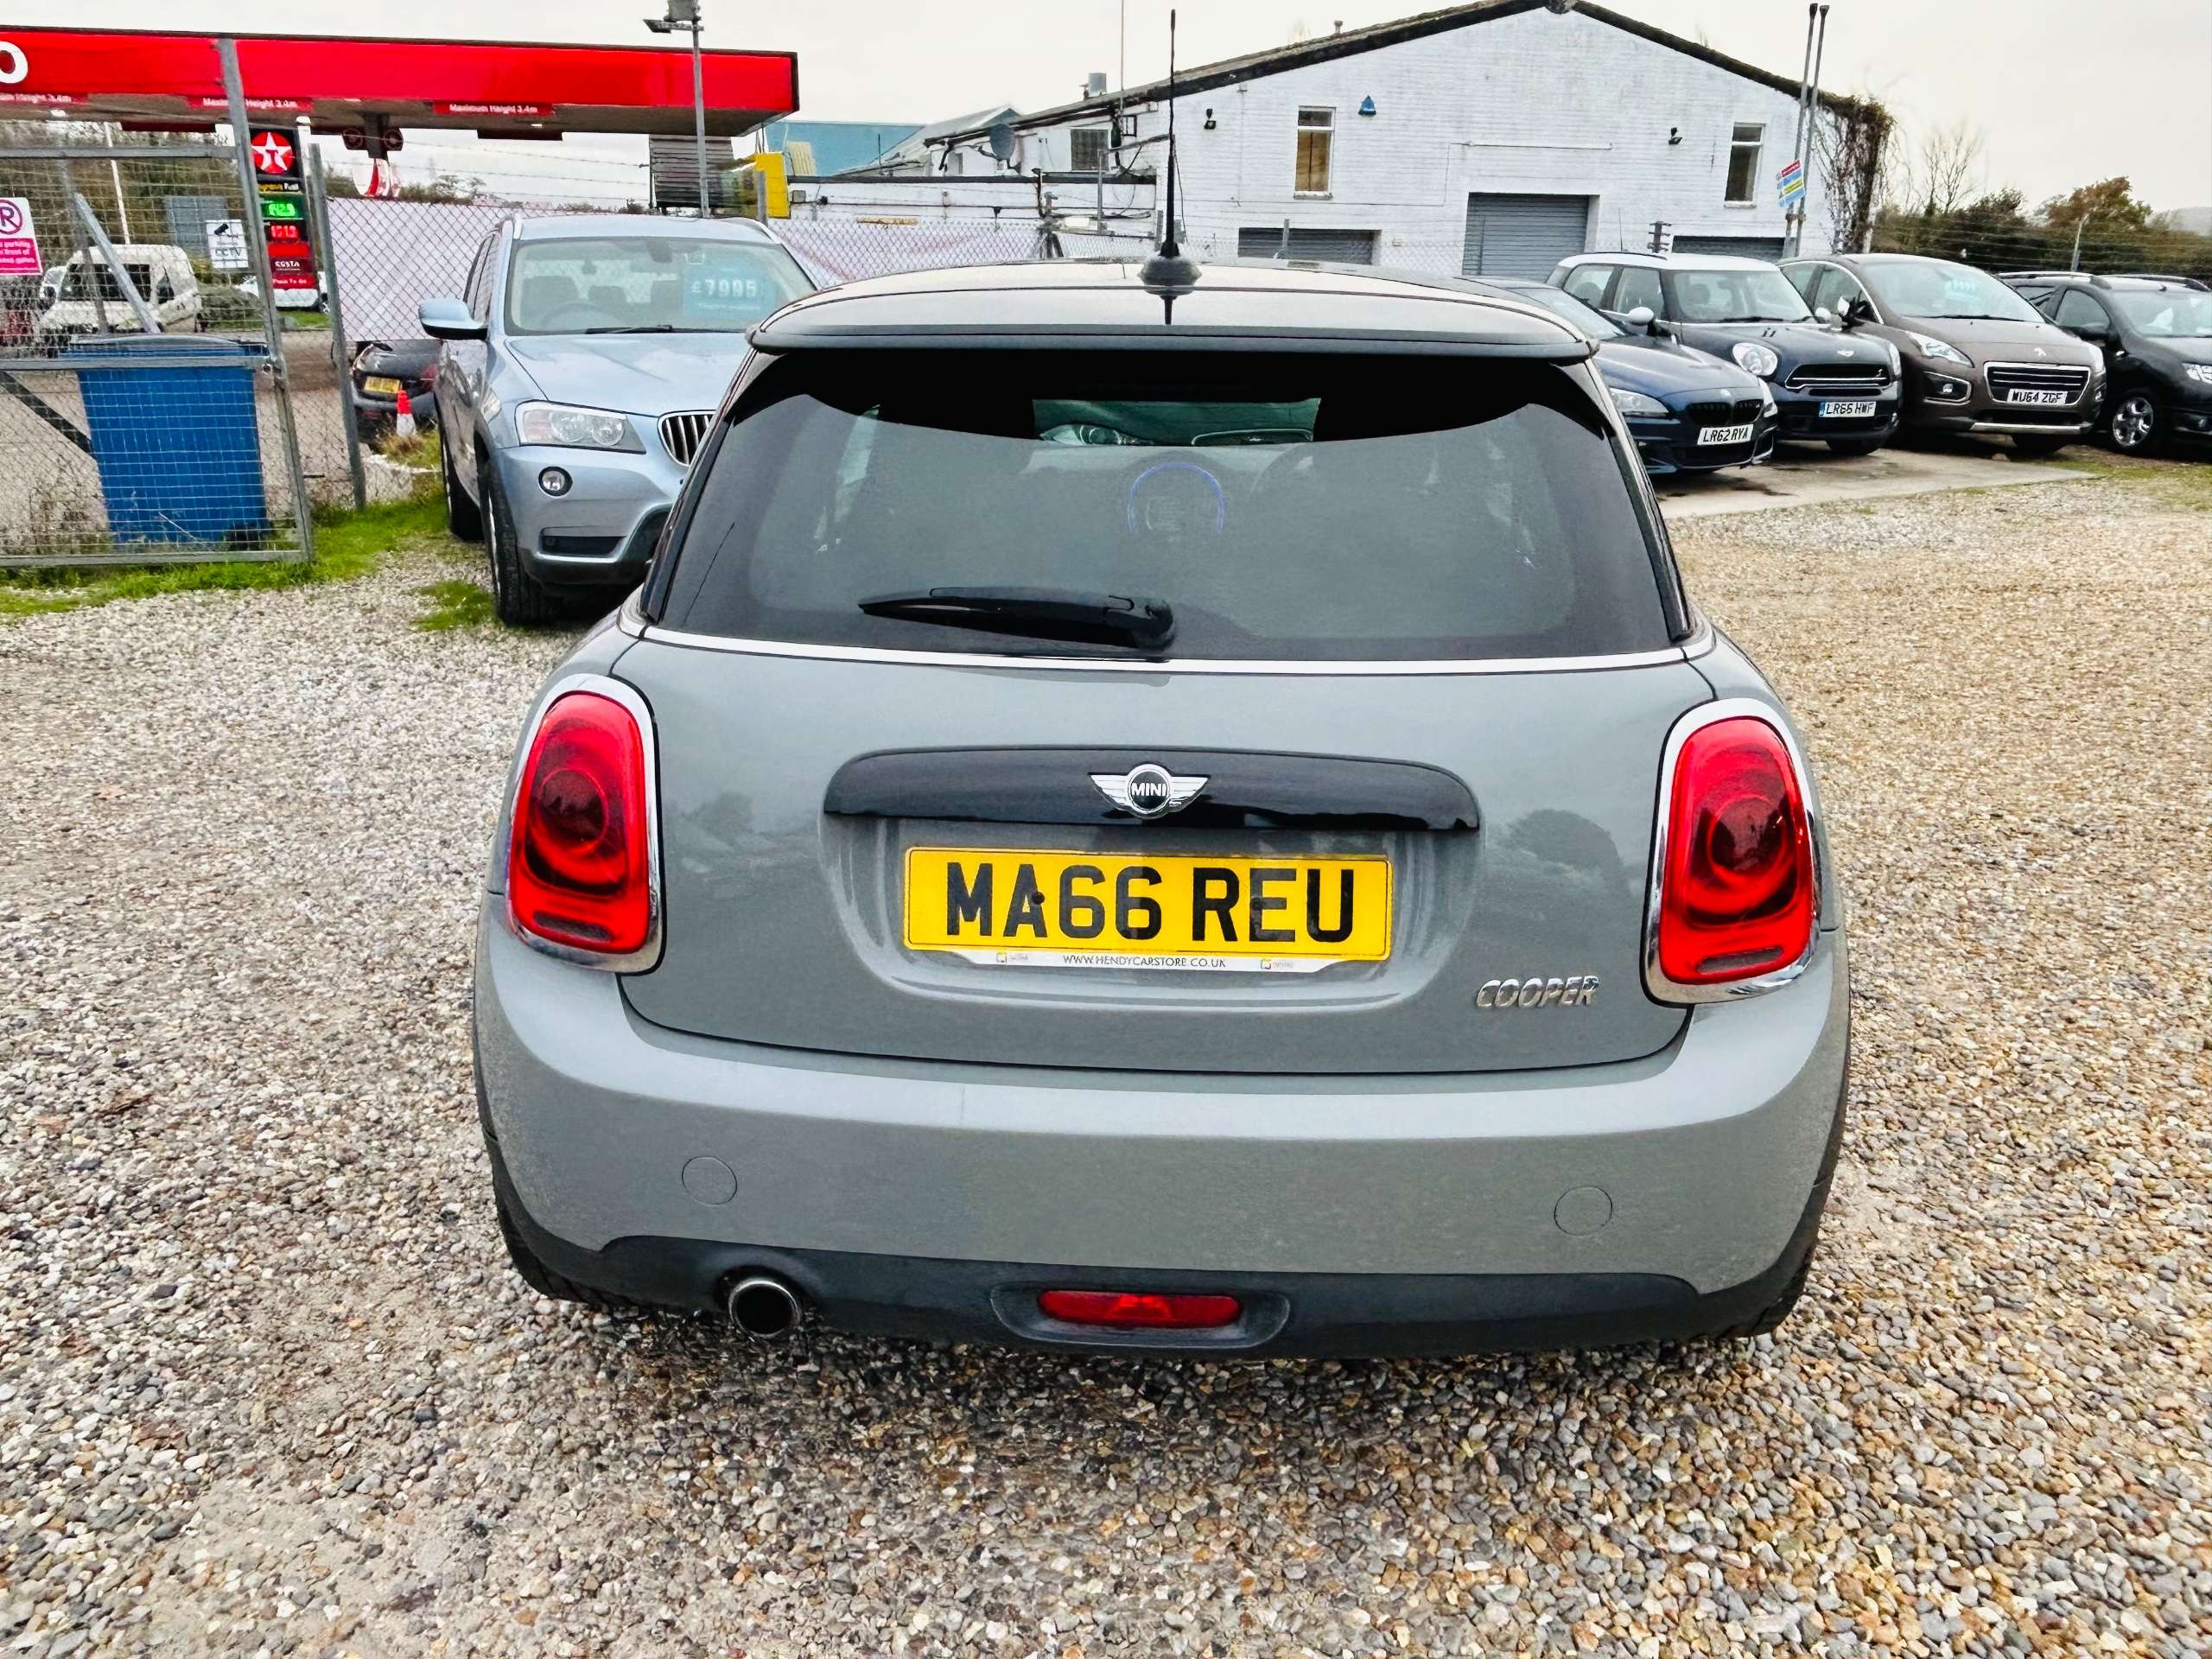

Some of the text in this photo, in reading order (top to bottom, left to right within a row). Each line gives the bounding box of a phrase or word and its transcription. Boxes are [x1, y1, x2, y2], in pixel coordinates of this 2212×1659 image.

[1703, 427, 1749, 442] LR62 RYA
[1130, 782, 1167, 797] MINI
[946, 861, 1355, 943] MA66 REU
[1064, 953, 1226, 969] WWW.HENDYCARSTORE.CO.UK
[1476, 975, 1600, 1008] COOPER
